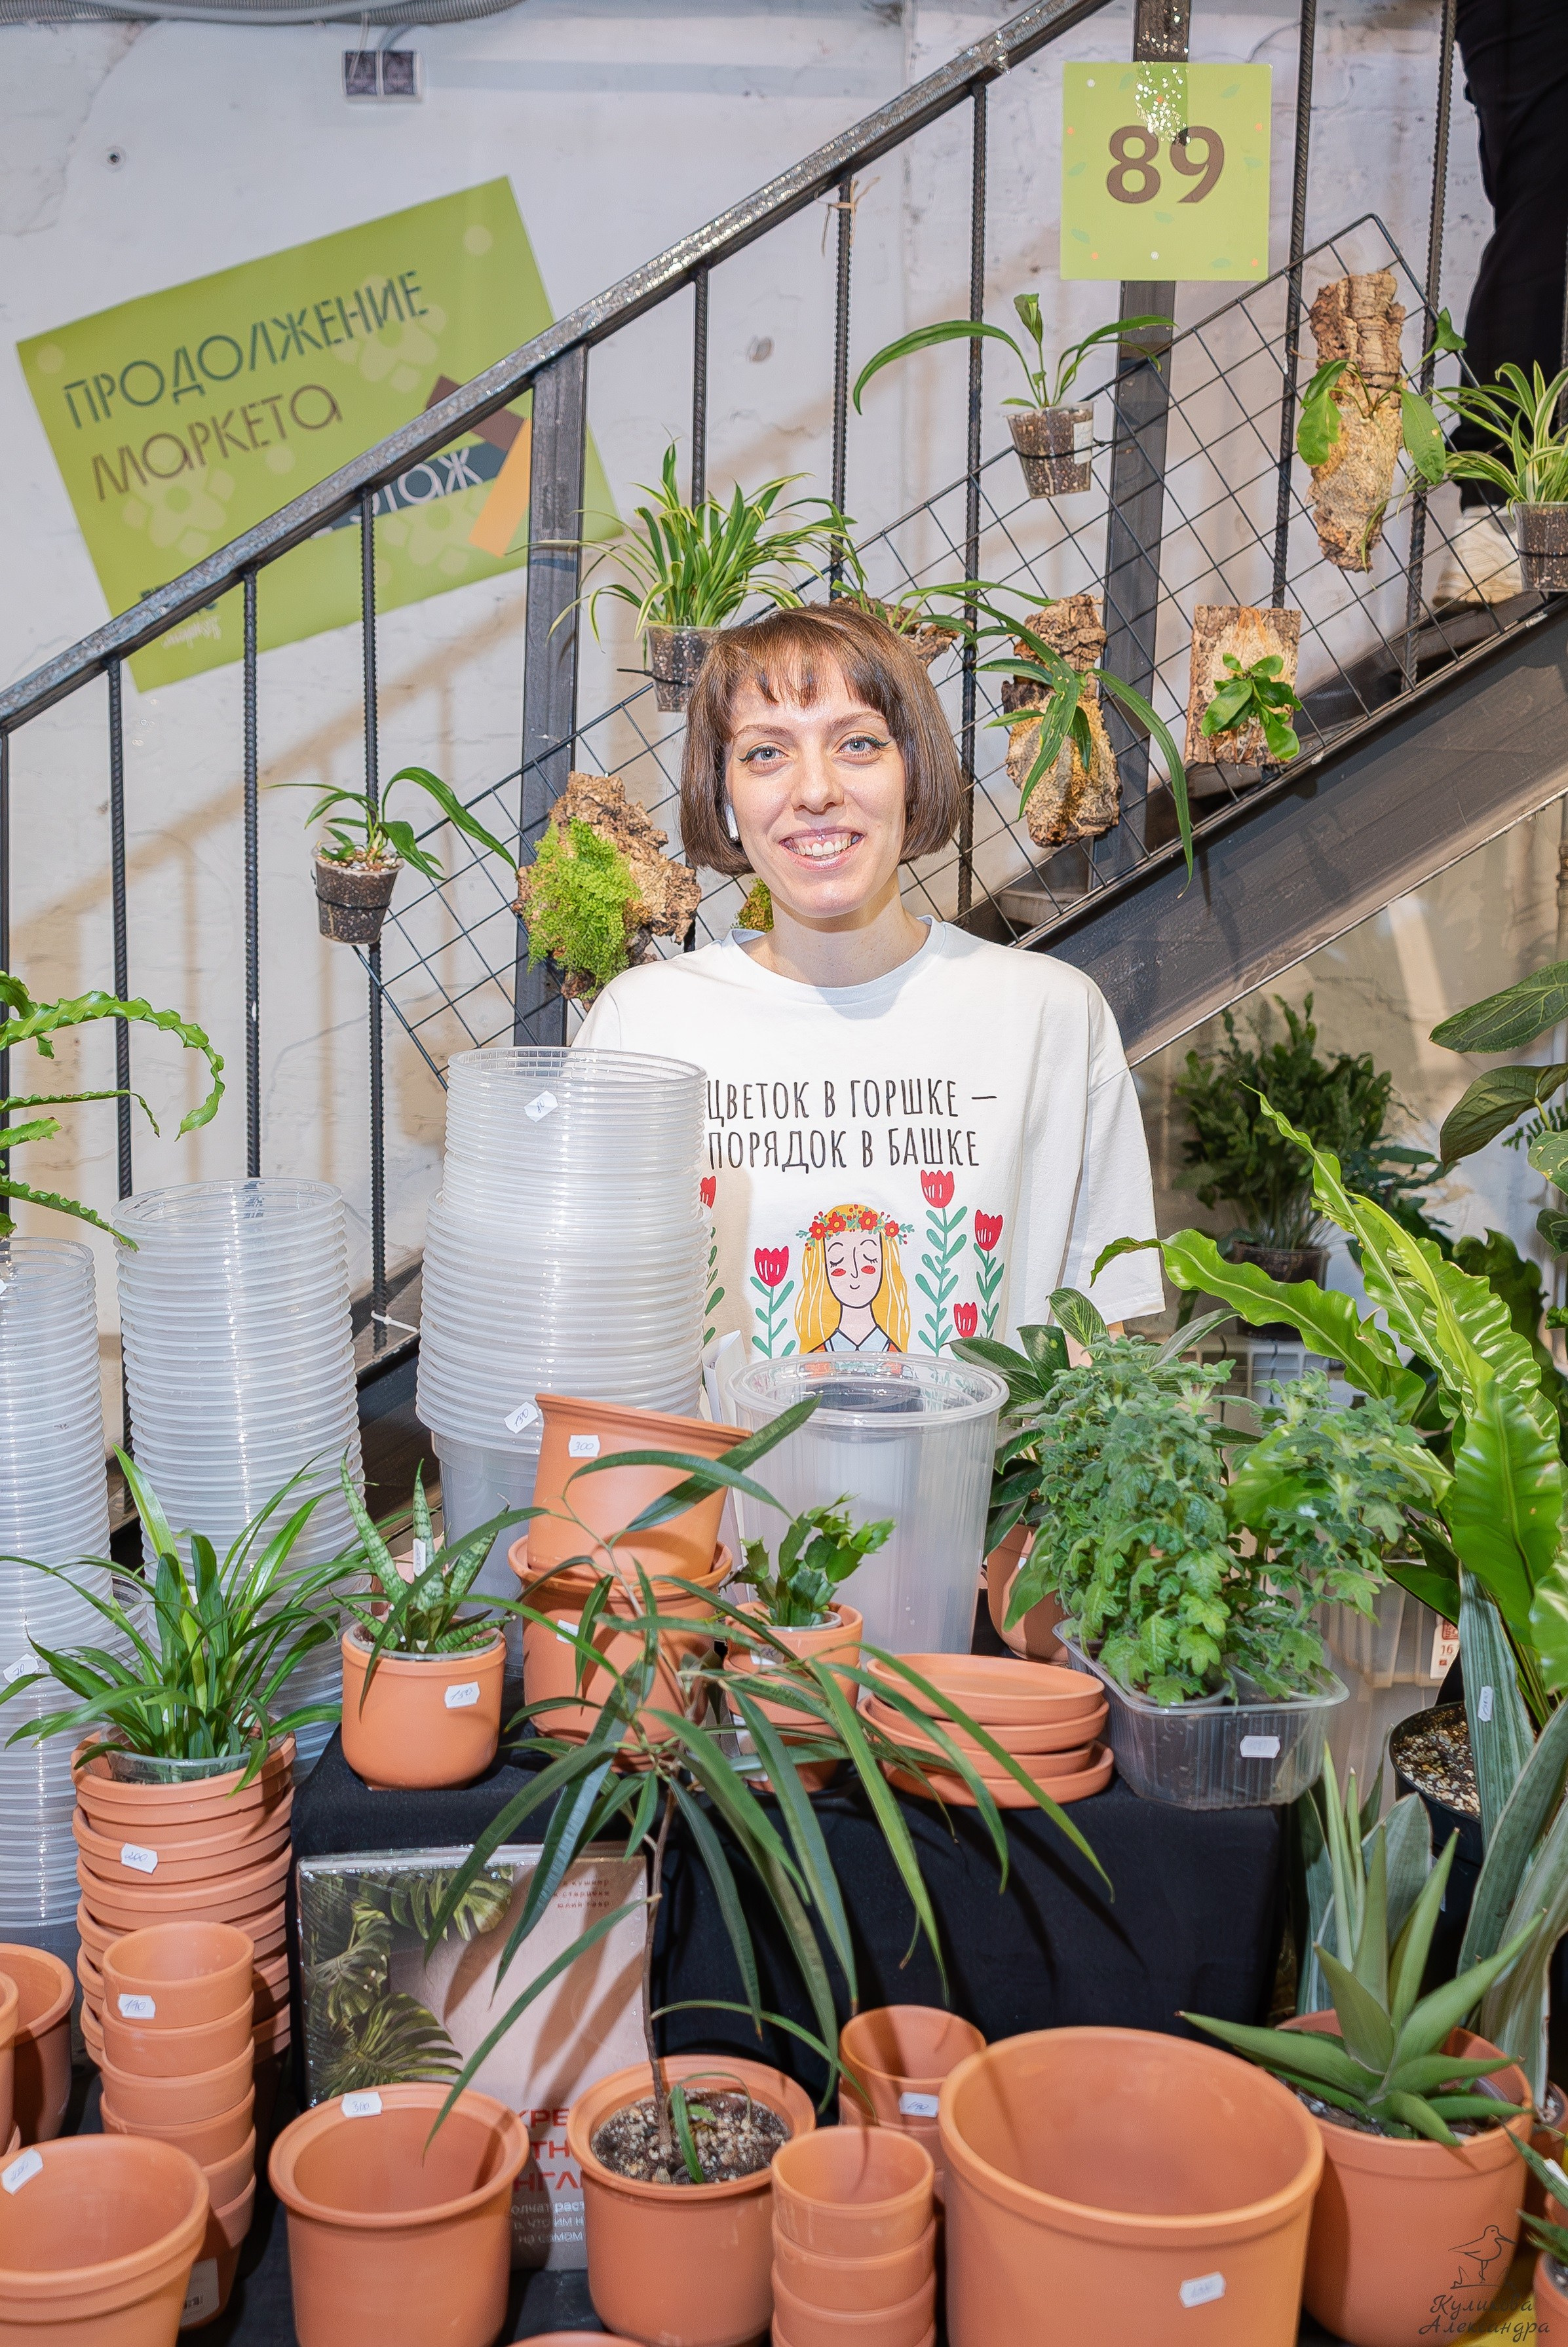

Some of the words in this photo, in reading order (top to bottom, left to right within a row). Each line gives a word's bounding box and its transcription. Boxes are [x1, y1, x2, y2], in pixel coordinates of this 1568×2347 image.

[1106, 124, 1225, 204] 89
[64, 270, 429, 430] ПРОДОЛЖЕНИЕ
[706, 1079, 810, 1127] ЦВЕТОК
[824, 1080, 836, 1118] В
[851, 1078, 959, 1118] ГОРШКЕ
[709, 1130, 847, 1174] ПОРЯДОК
[862, 1130, 873, 1168] В
[888, 1127, 980, 1166] БАШКЕ
[575, 1442, 594, 1451] 300
[12, 1664, 25, 1677] 70
[1441, 1644, 1453, 1655] 16
